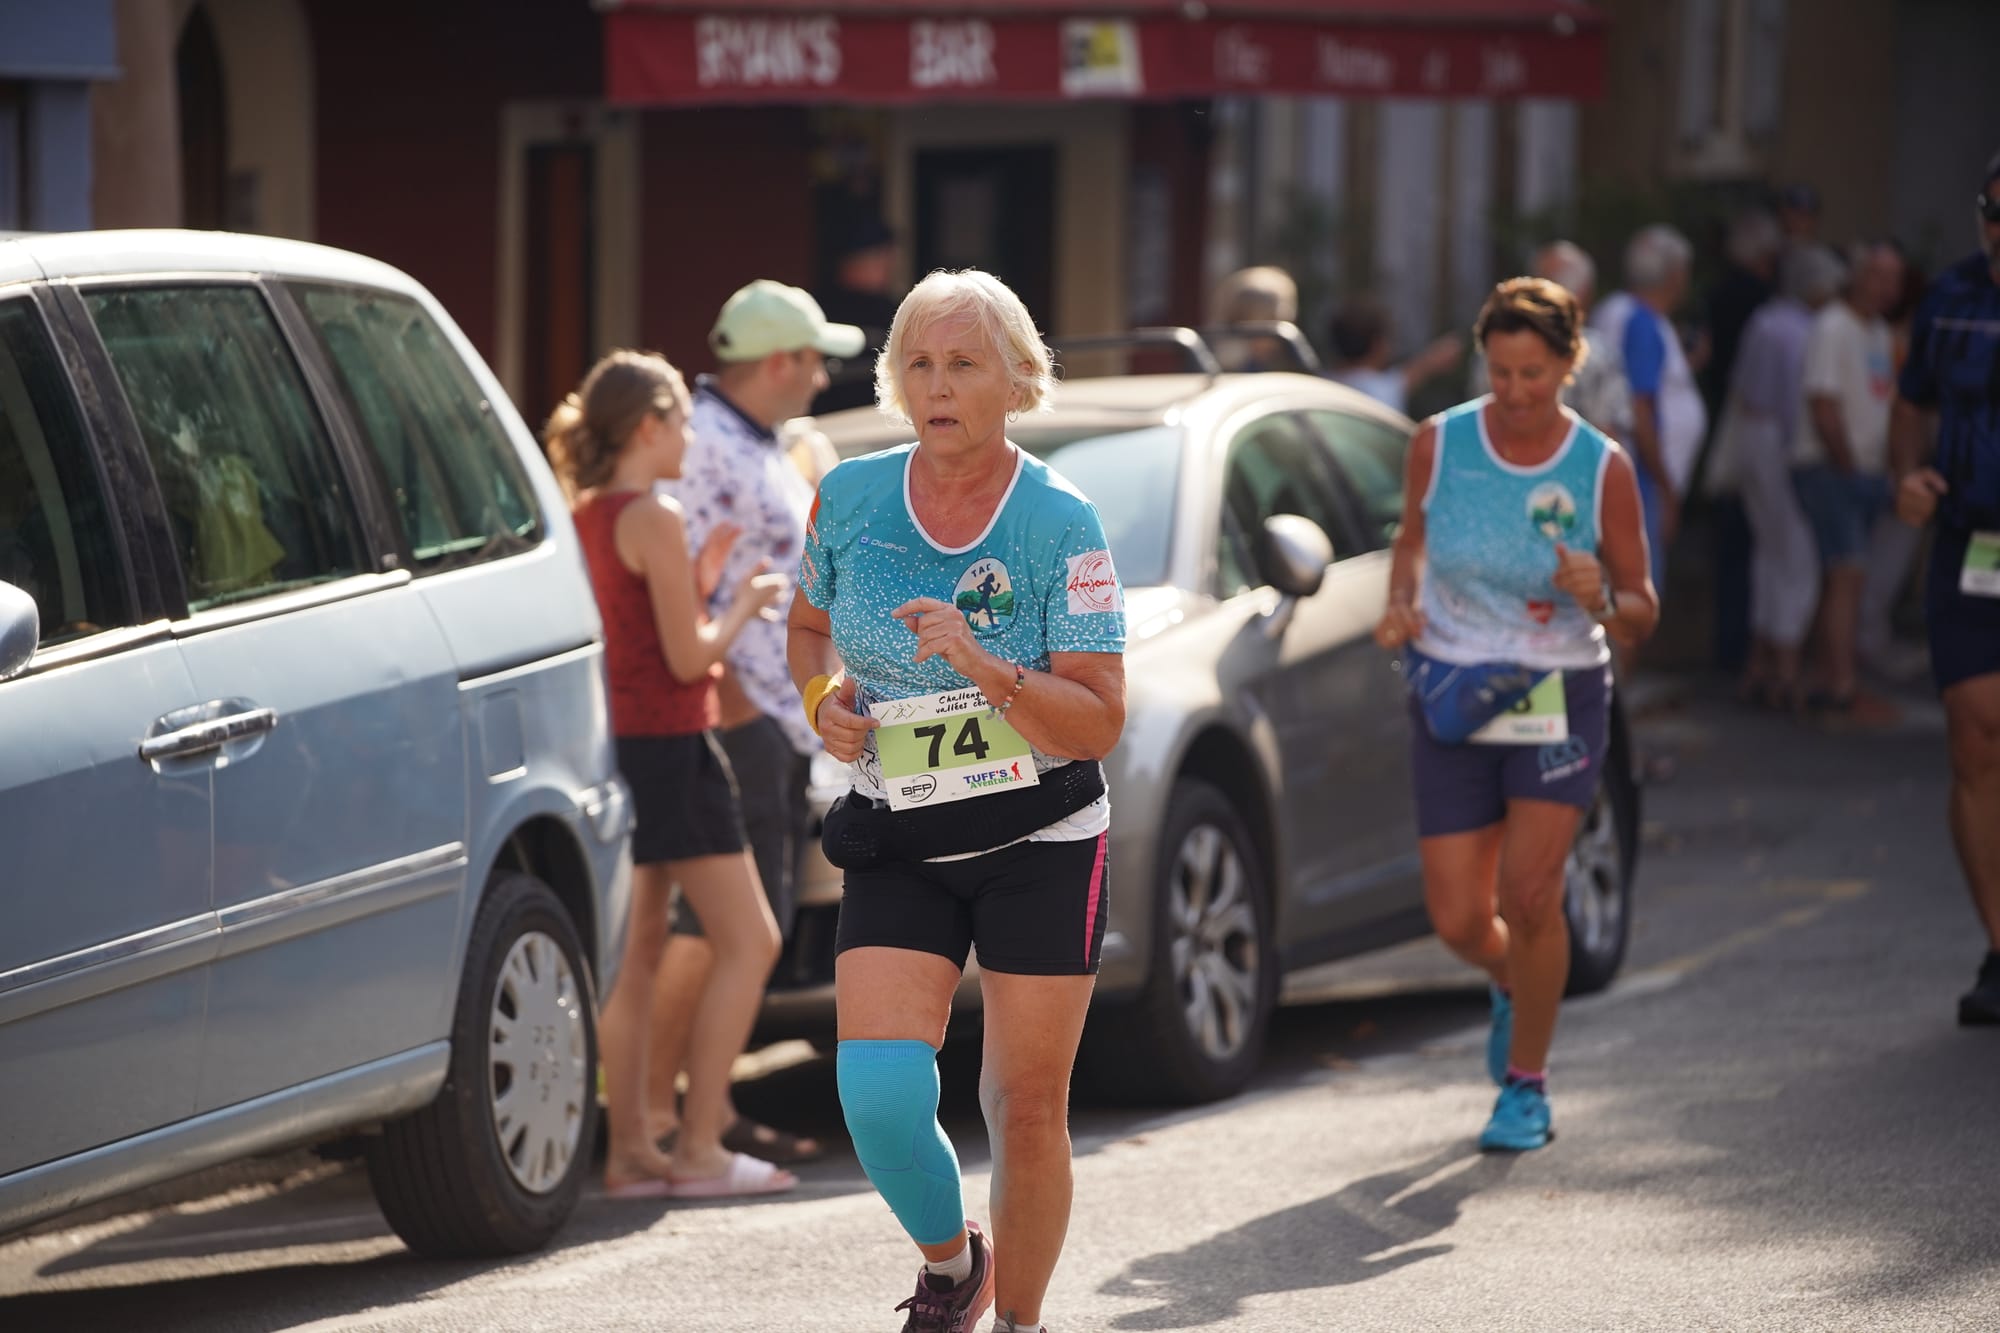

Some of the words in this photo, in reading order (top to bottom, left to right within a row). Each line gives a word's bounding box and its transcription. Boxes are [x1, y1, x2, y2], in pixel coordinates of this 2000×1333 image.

[971, 563, 991, 577] TAC
[913, 717, 990, 768] 74
[963, 769, 1008, 784] TUFF'S
[970, 775, 1014, 789] Aventure
[901, 783, 932, 796] BFP
